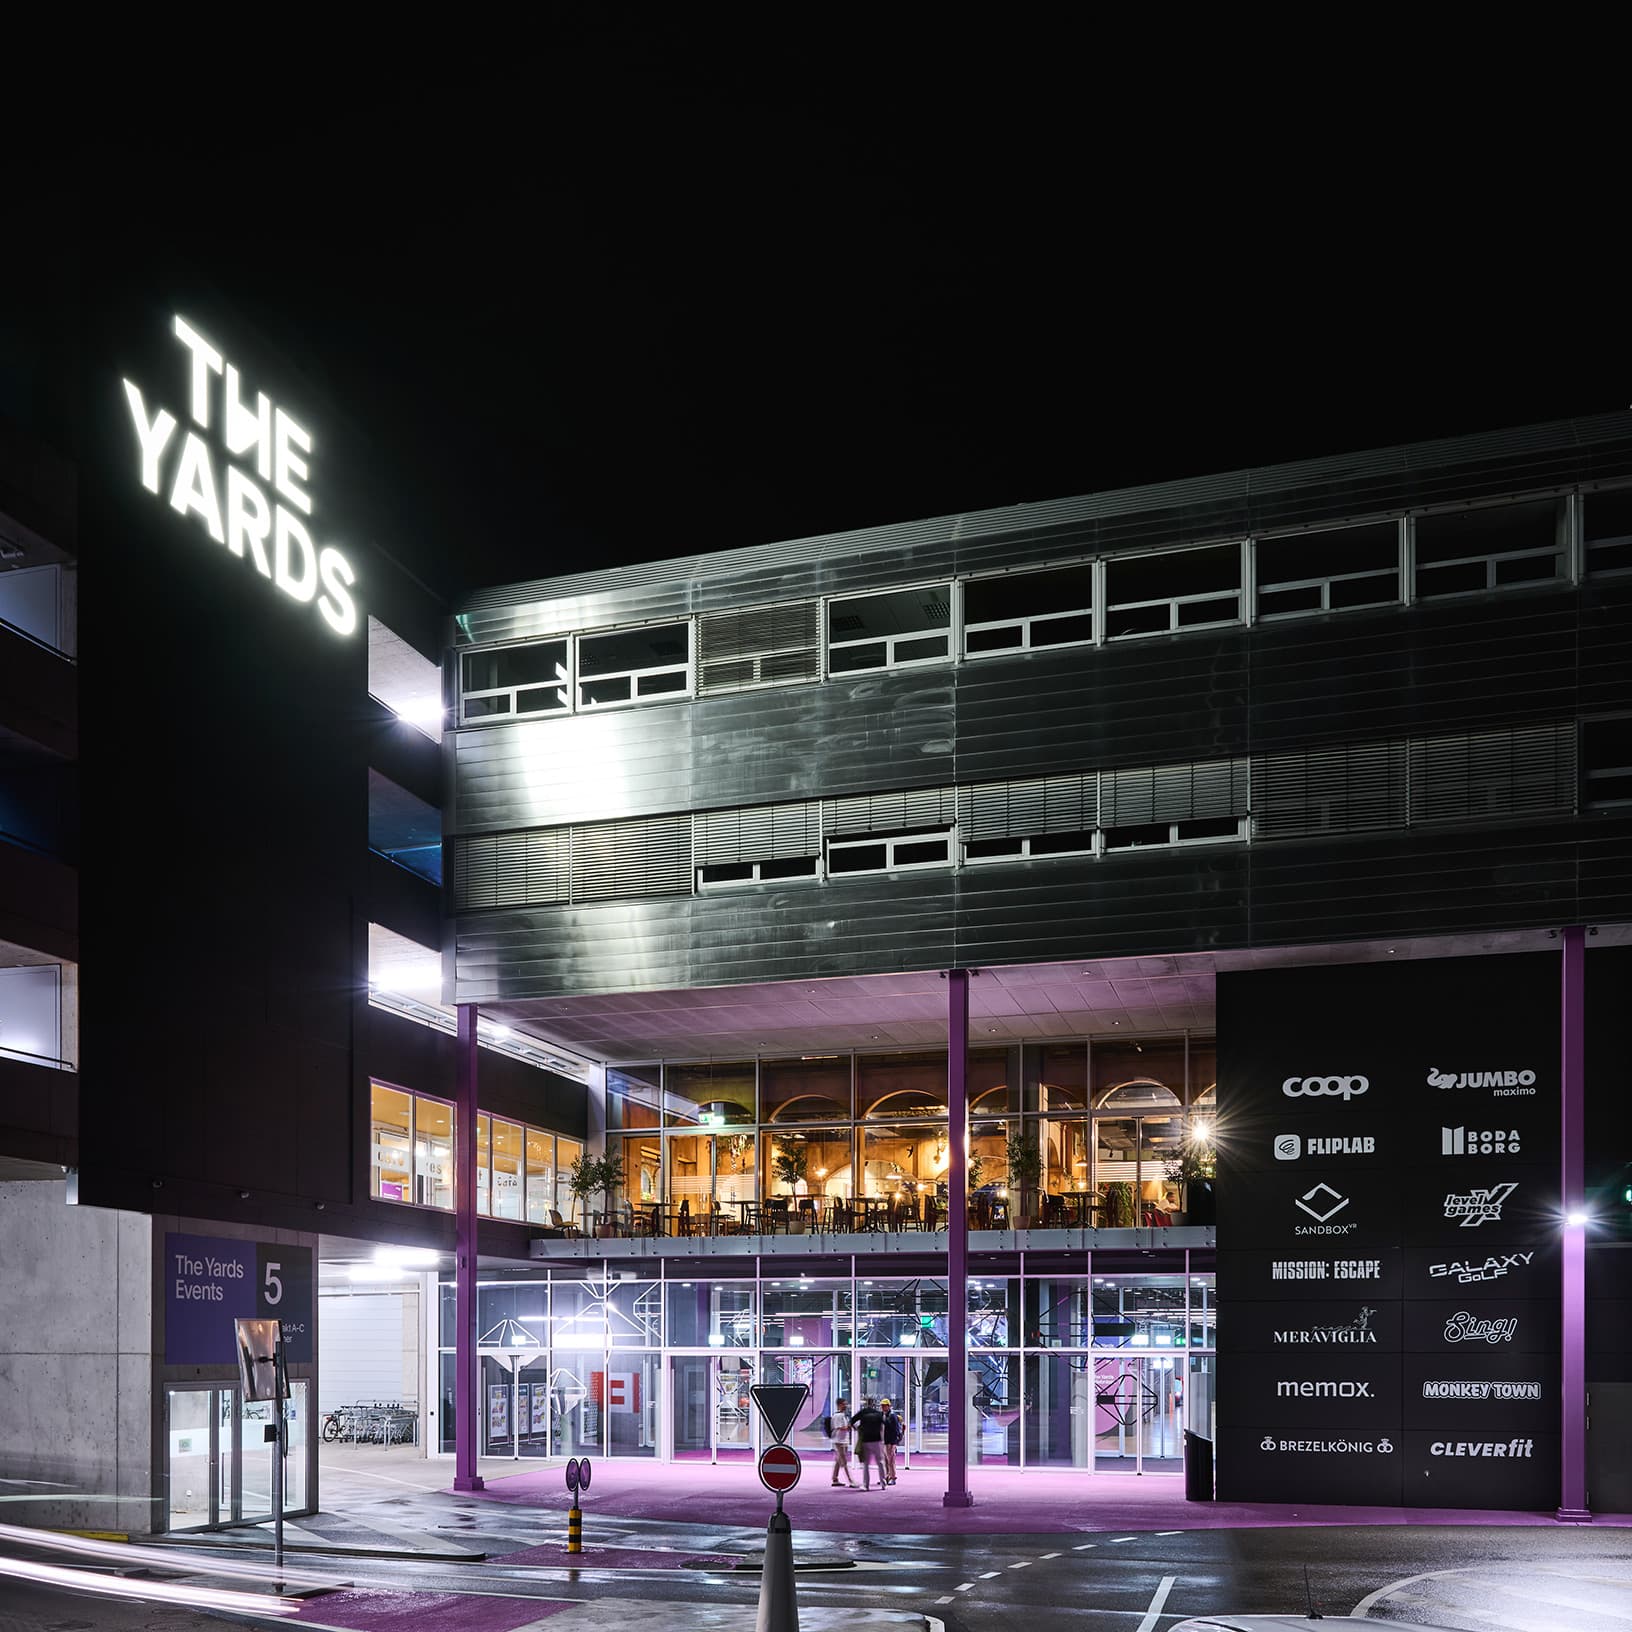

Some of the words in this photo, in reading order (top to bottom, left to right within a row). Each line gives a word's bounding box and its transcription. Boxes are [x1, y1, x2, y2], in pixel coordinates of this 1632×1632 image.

[174, 314, 312, 515] THE
[122, 377, 357, 635] YARDS
[1282, 1075, 1370, 1101] coop
[1456, 1069, 1536, 1088] JUMBO
[1494, 1087, 1536, 1097] maximo
[1307, 1136, 1375, 1155] FLIPLAB
[1467, 1130, 1521, 1142] BODA
[1467, 1143, 1521, 1155] BORG
[1444, 1204, 1502, 1217] games
[175, 1255, 203, 1276] The
[205, 1257, 244, 1279] Yards
[1272, 1260, 1330, 1280] MISSION:
[1333, 1260, 1381, 1280] ESCAPE
[1428, 1251, 1534, 1278] GALAXY
[175, 1279, 224, 1301] Events
[264, 1262, 283, 1305] 5
[1273, 1331, 1377, 1343] MERAVIGLIA
[1443, 1311, 1518, 1344] Sing!
[1277, 1380, 1375, 1398] memox.
[1422, 1381, 1492, 1400] MONKEY
[1492, 1381, 1542, 1400] TOWN
[1280, 1438, 1373, 1453] BREZELKÖNIG
